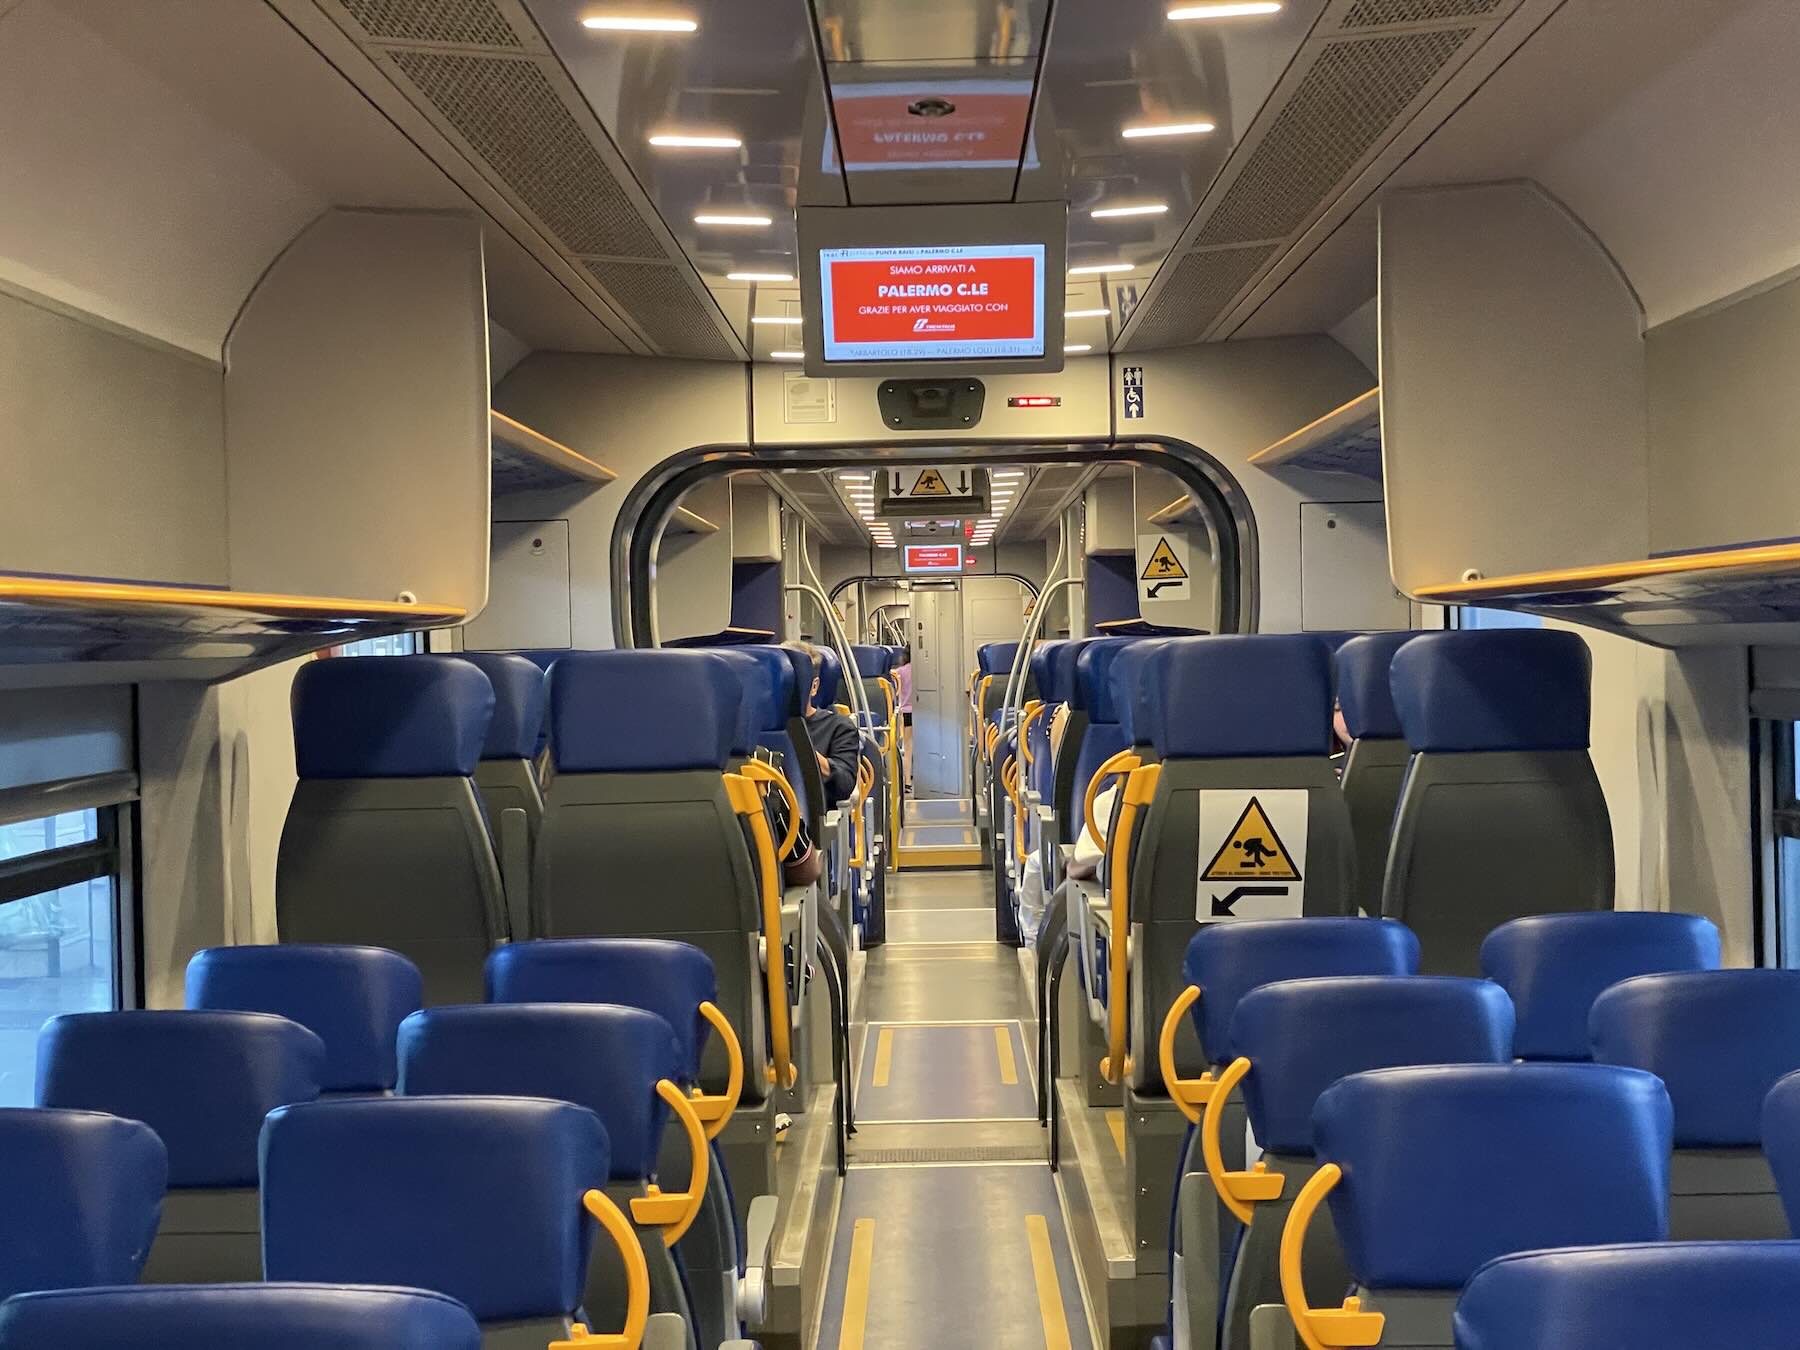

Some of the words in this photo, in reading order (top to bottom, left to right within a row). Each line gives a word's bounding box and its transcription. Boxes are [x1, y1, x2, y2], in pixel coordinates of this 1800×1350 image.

[889, 265, 923, 275] SIAMO
[924, 264, 966, 274] ARRIVATI
[967, 264, 976, 274] A
[878, 283, 952, 298] PALERMO
[957, 282, 989, 297] C.LE
[858, 305, 890, 315] GRAZIE
[892, 305, 908, 314] PER
[909, 304, 931, 314] AVER
[932, 303, 984, 313] VIAGGIATO
[985, 303, 1009, 312] CON
